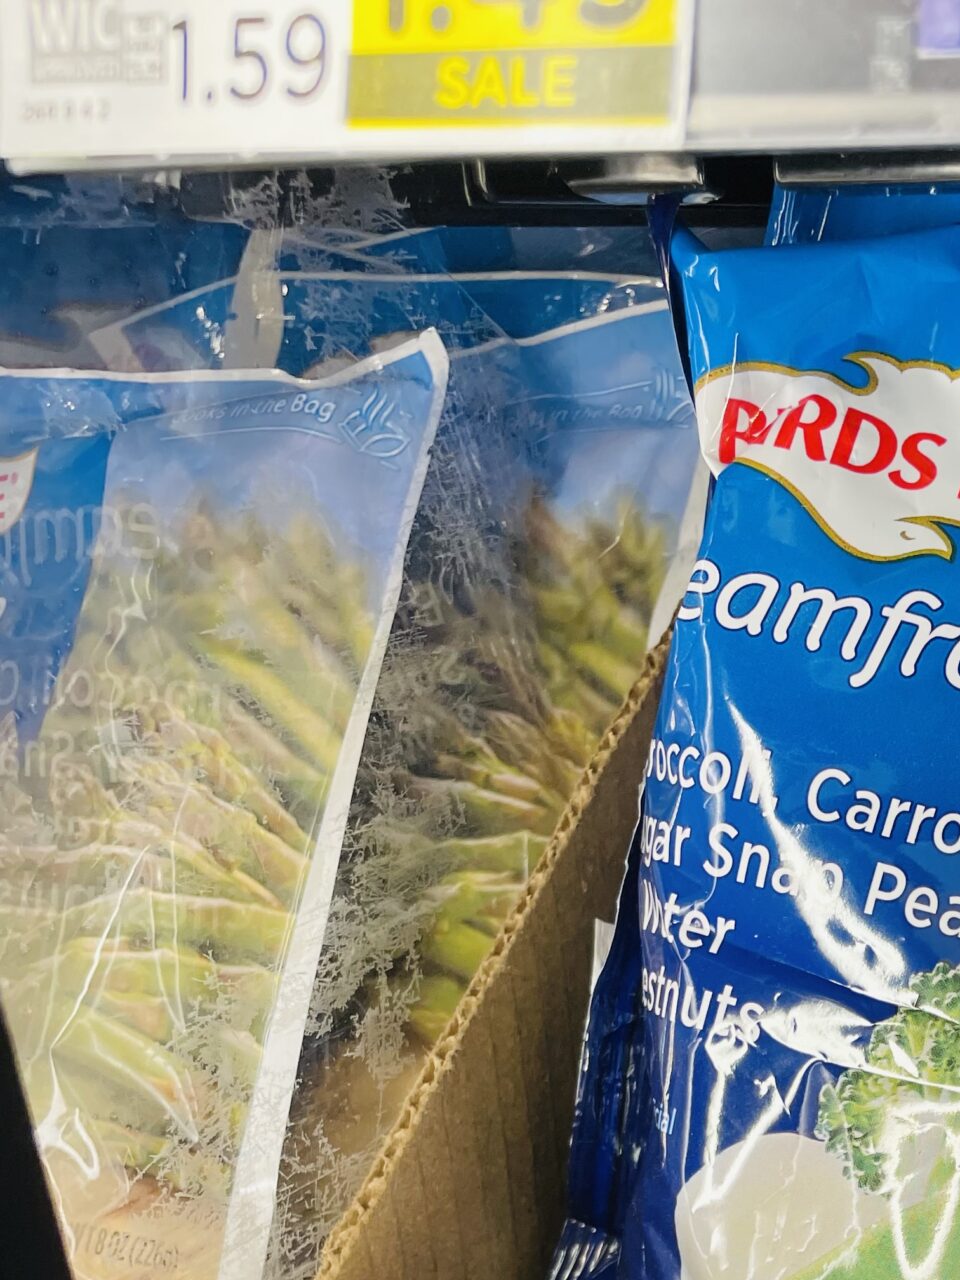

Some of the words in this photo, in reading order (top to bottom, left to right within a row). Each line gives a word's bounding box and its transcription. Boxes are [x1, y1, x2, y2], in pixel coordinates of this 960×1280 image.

[172, 13, 326, 99] 1.59
[434, 56, 577, 109] SALE
[290, 393, 336, 424] Bag
[647, 738, 779, 818] roccoli,
[642, 965, 765, 1044] estnuts
